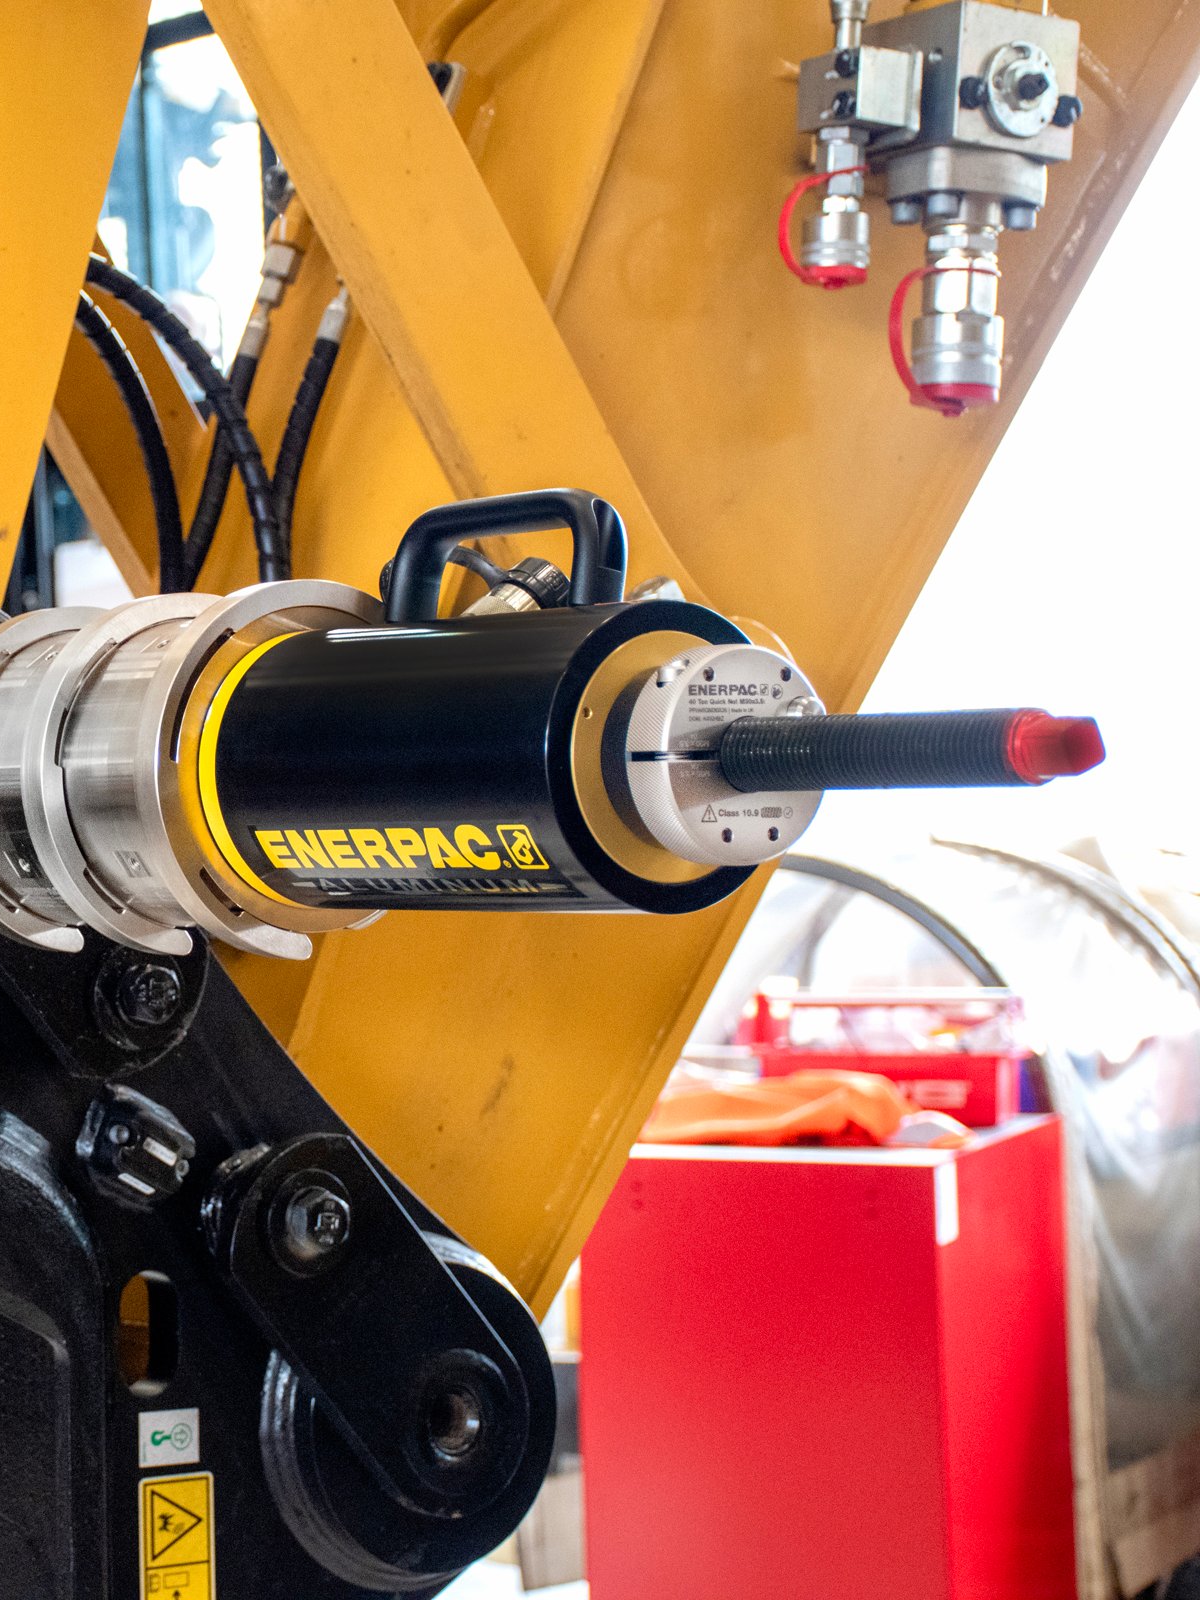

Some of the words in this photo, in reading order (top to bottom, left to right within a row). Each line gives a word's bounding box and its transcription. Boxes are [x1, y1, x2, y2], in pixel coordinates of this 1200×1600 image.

[688, 684, 757, 696] ENERPAC
[719, 809, 739, 817] Class
[743, 809, 759, 817] 10.9
[255, 824, 501, 871] ENERPAC
[319, 879, 539, 893] ALUMINUM
